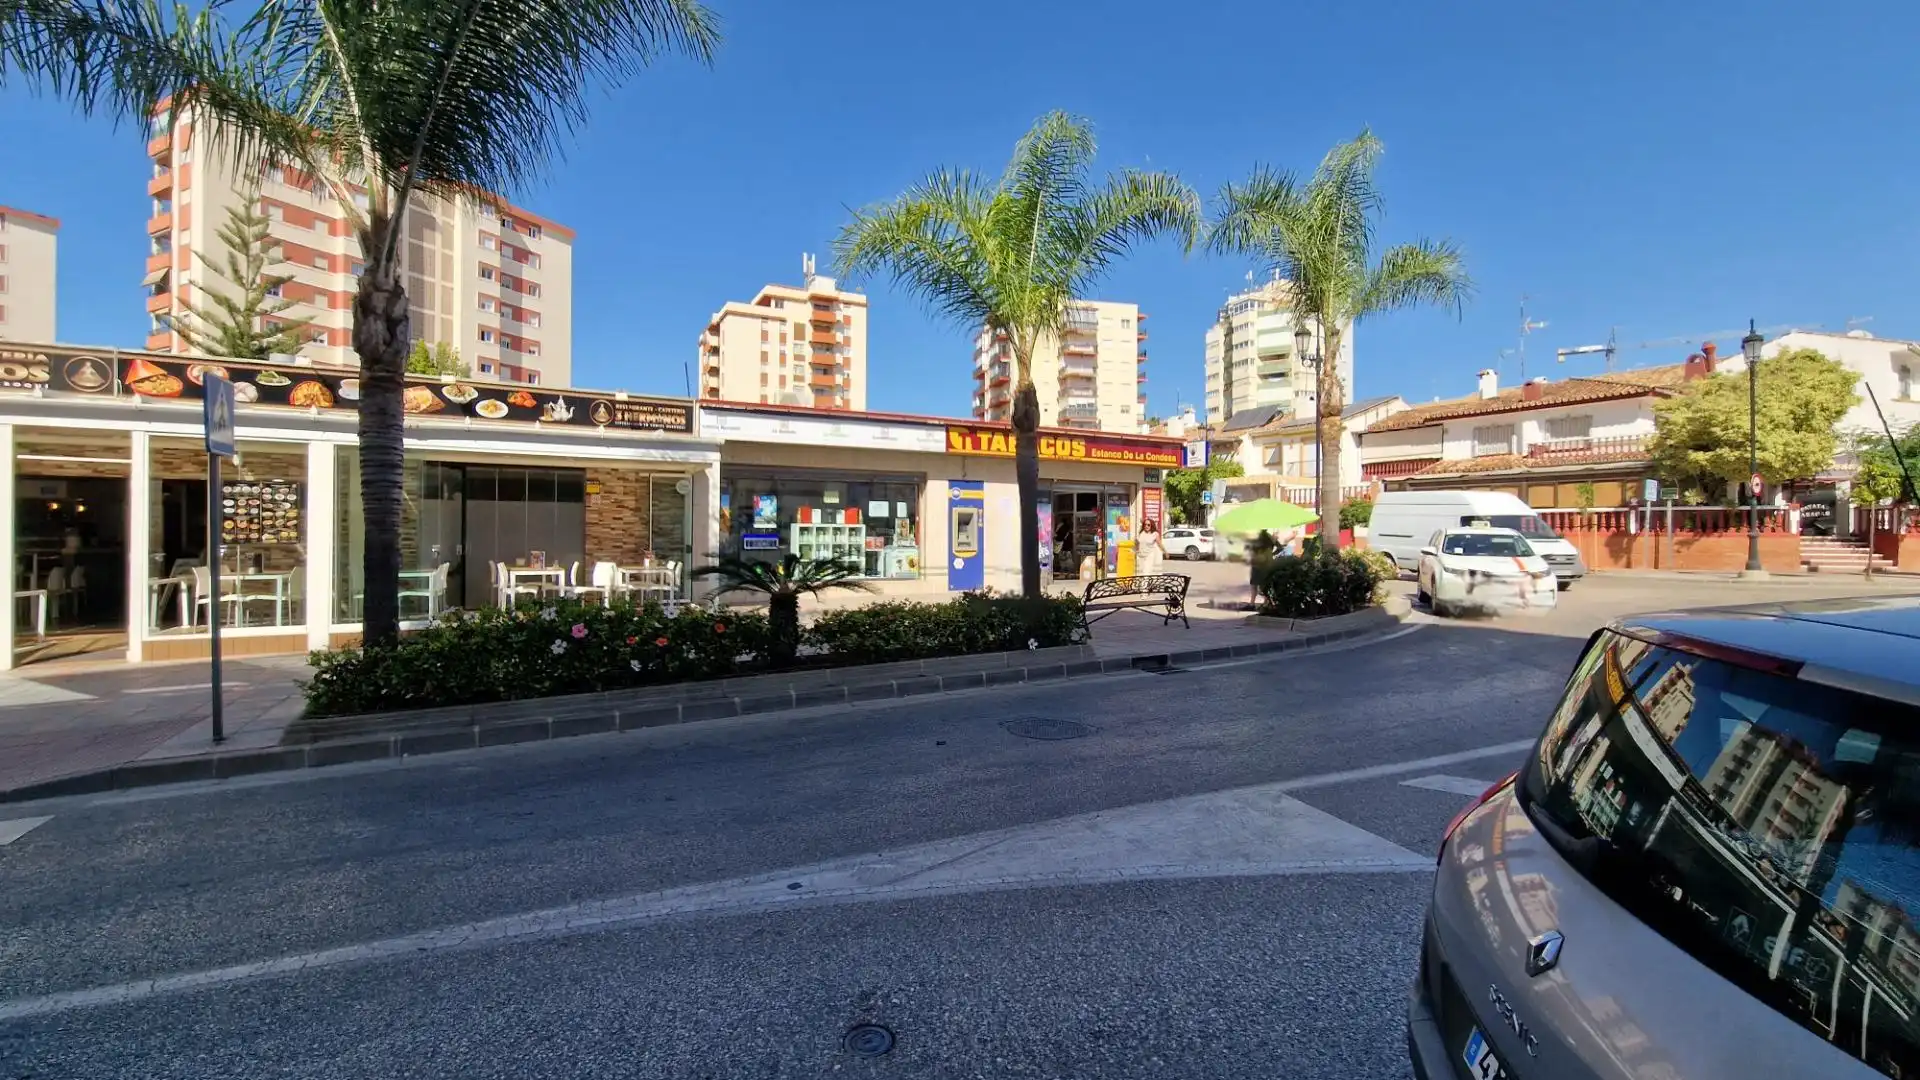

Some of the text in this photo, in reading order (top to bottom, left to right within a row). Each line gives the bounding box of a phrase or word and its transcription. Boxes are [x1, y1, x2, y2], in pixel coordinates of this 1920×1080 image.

[1091, 448, 1177, 462] Estanco De La Condesa
[1489, 984, 1539, 1057] SCENIC
